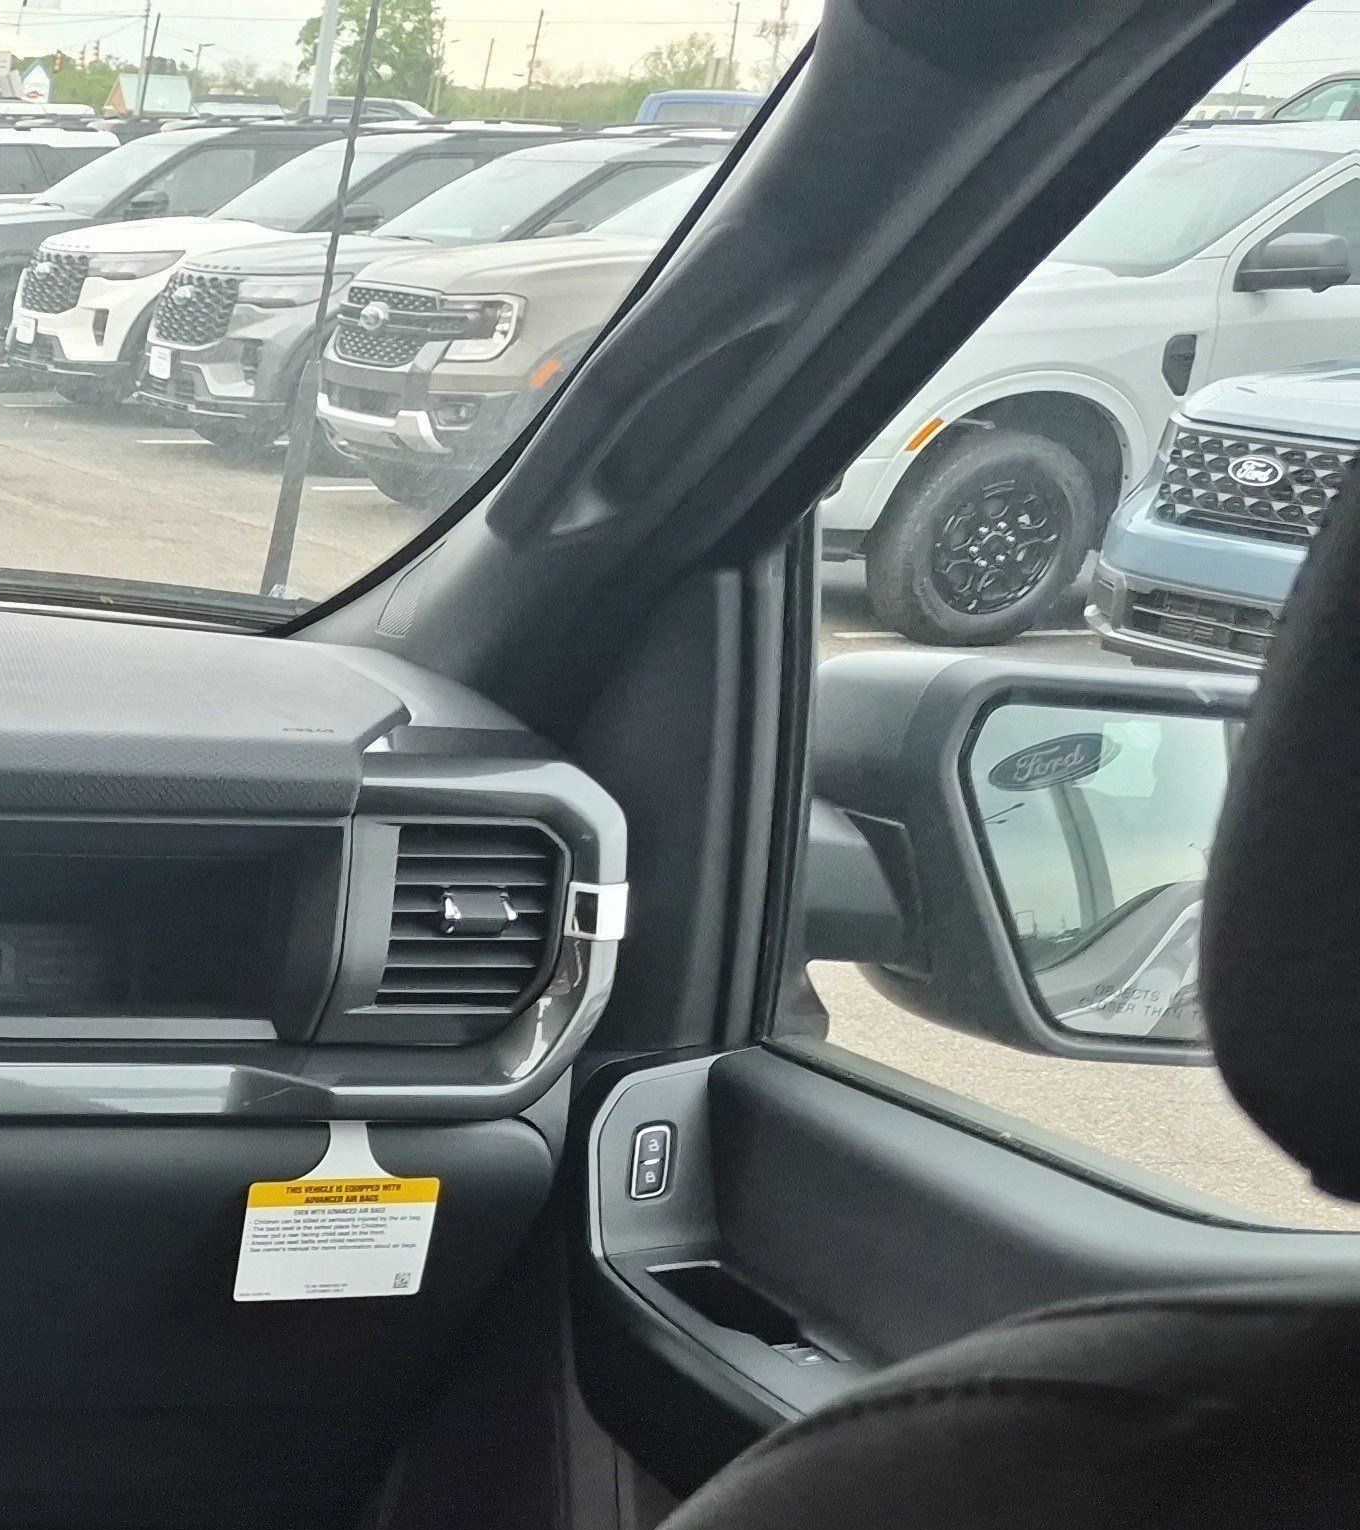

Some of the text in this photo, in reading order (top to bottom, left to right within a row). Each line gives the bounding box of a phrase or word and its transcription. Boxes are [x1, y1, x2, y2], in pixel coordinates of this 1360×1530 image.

[1012, 743, 1086, 782] Ford
[285, 1186, 302, 1194] THIS
[304, 1185, 333, 1193] VEHICLE
[344, 1184, 380, 1192] EQUIPPED
[382, 1183, 402, 1191] WITH
[304, 1194, 380, 1204] ADVANCED AIR BAGS
